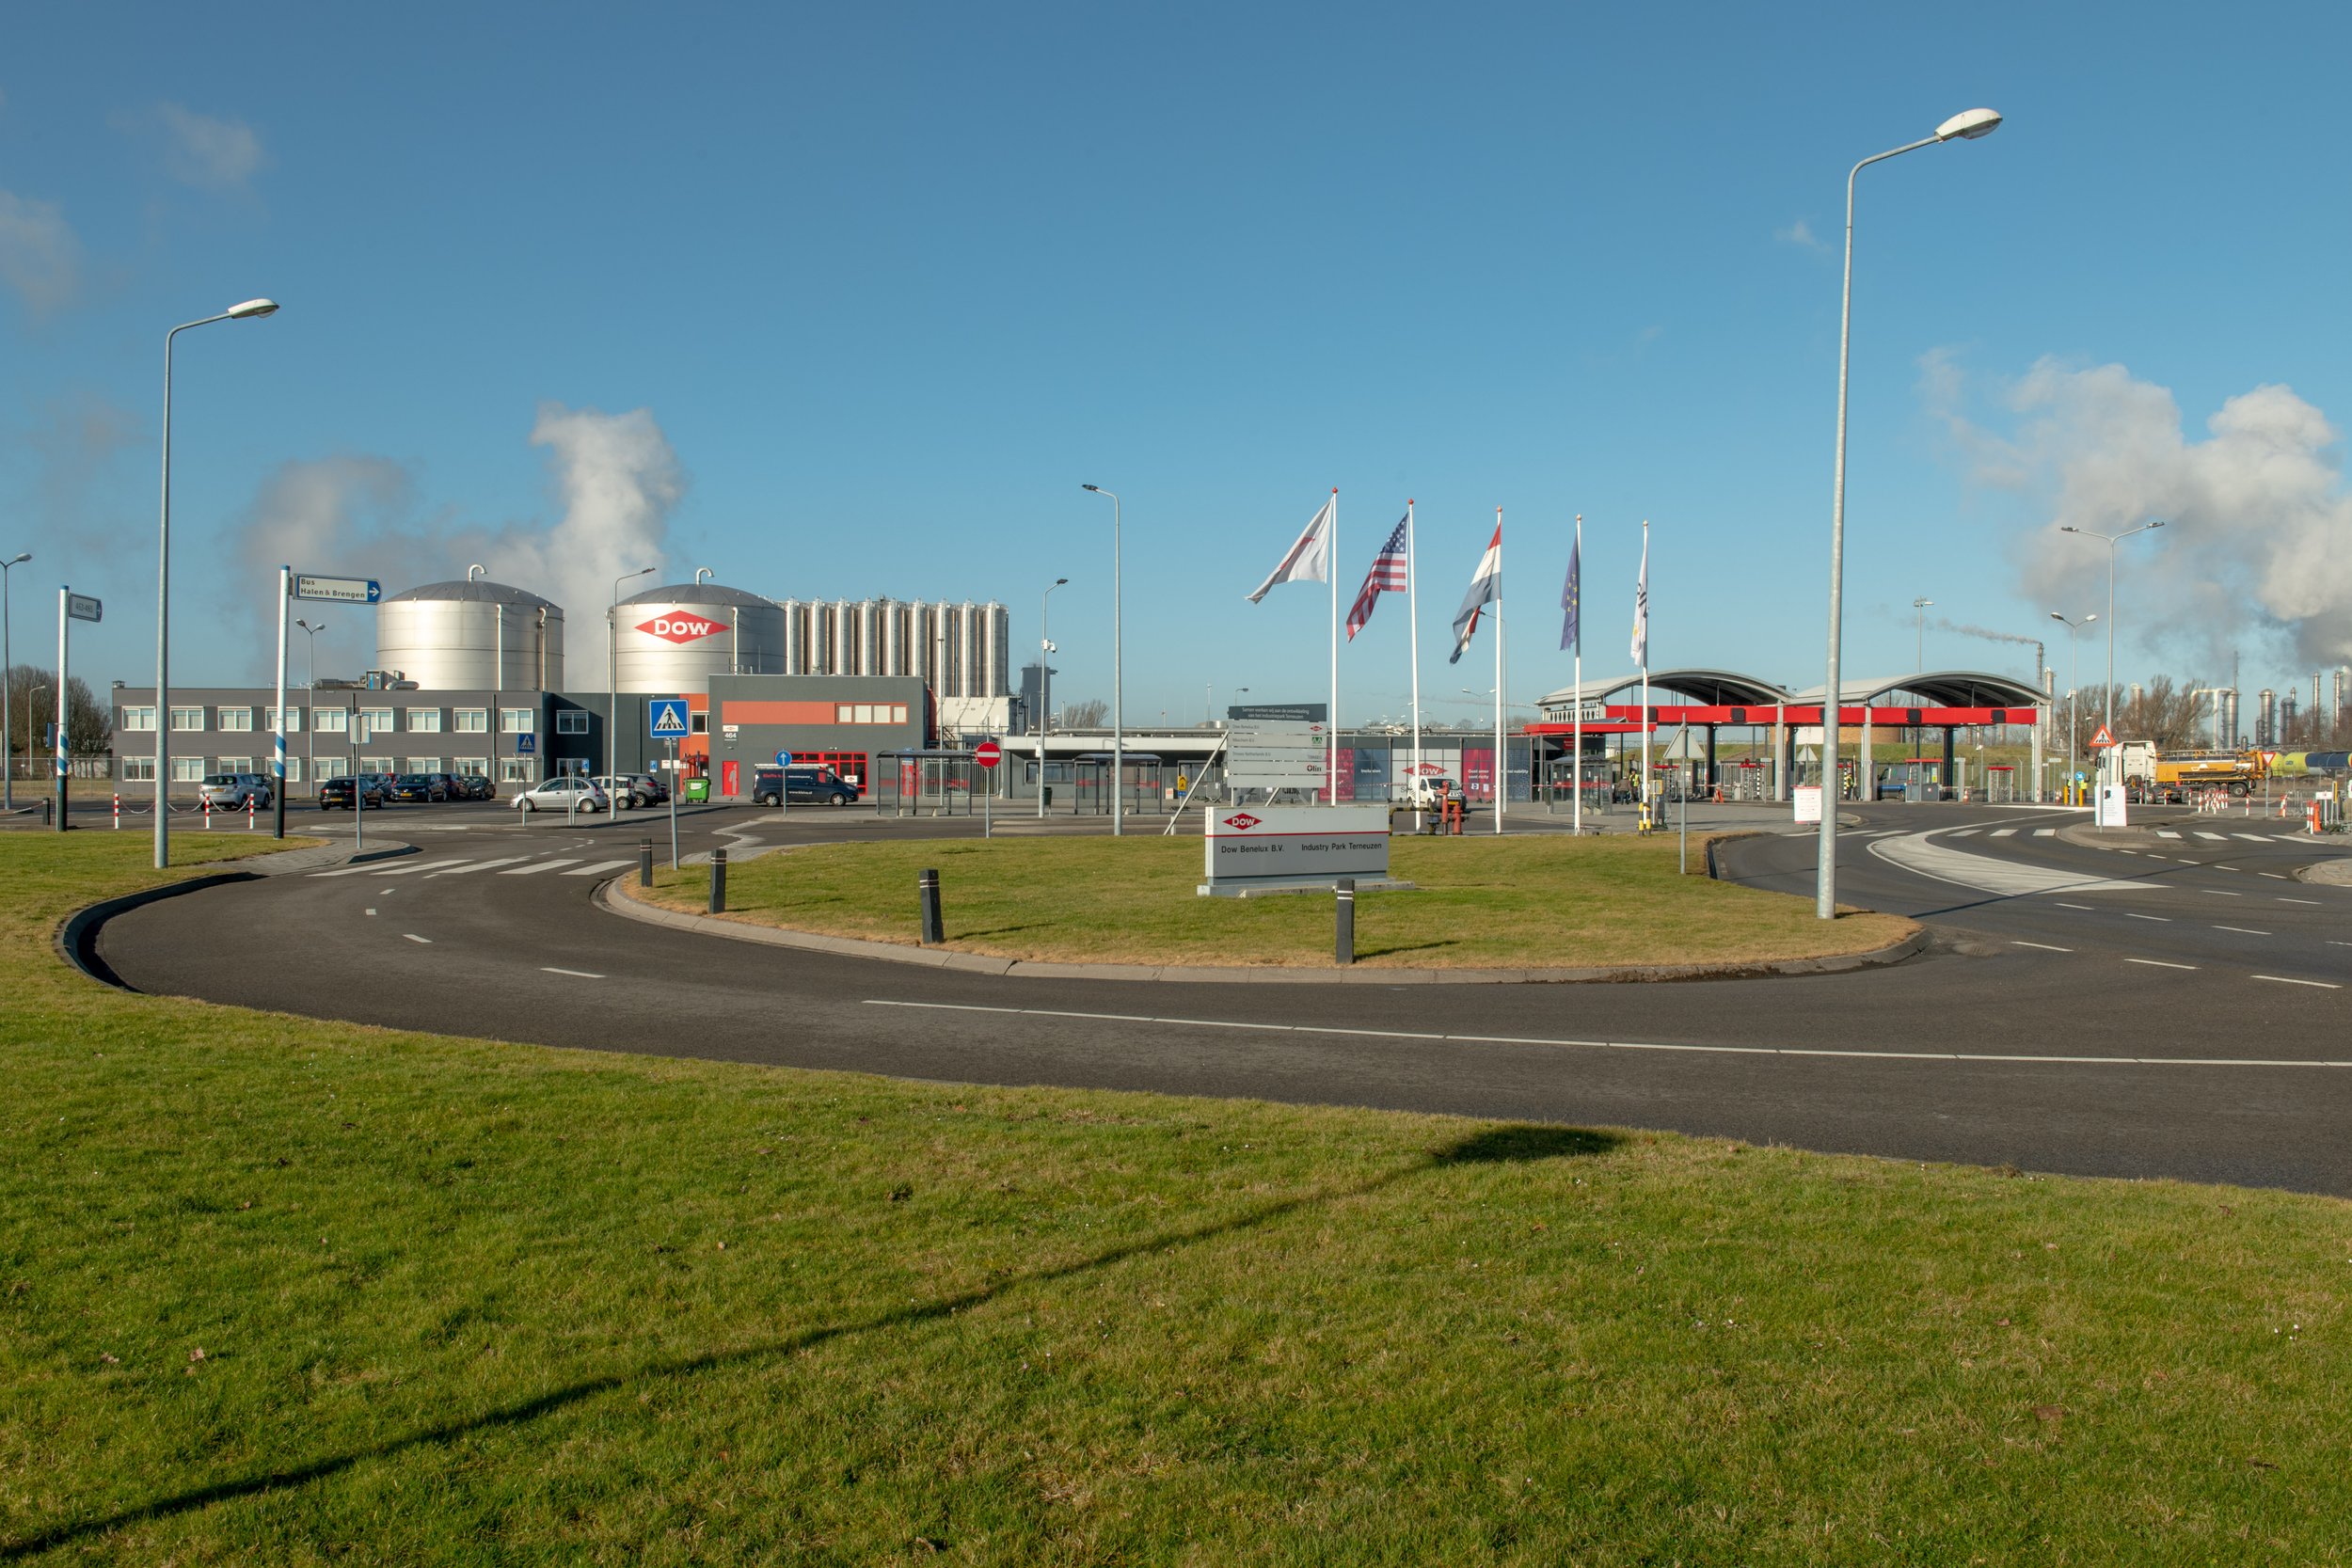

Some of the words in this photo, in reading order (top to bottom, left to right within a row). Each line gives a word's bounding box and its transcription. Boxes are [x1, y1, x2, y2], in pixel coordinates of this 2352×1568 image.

[654, 620, 711, 635] DOW
[1232, 817, 1255, 827] DOW
[1302, 843, 1328, 852] Industry
